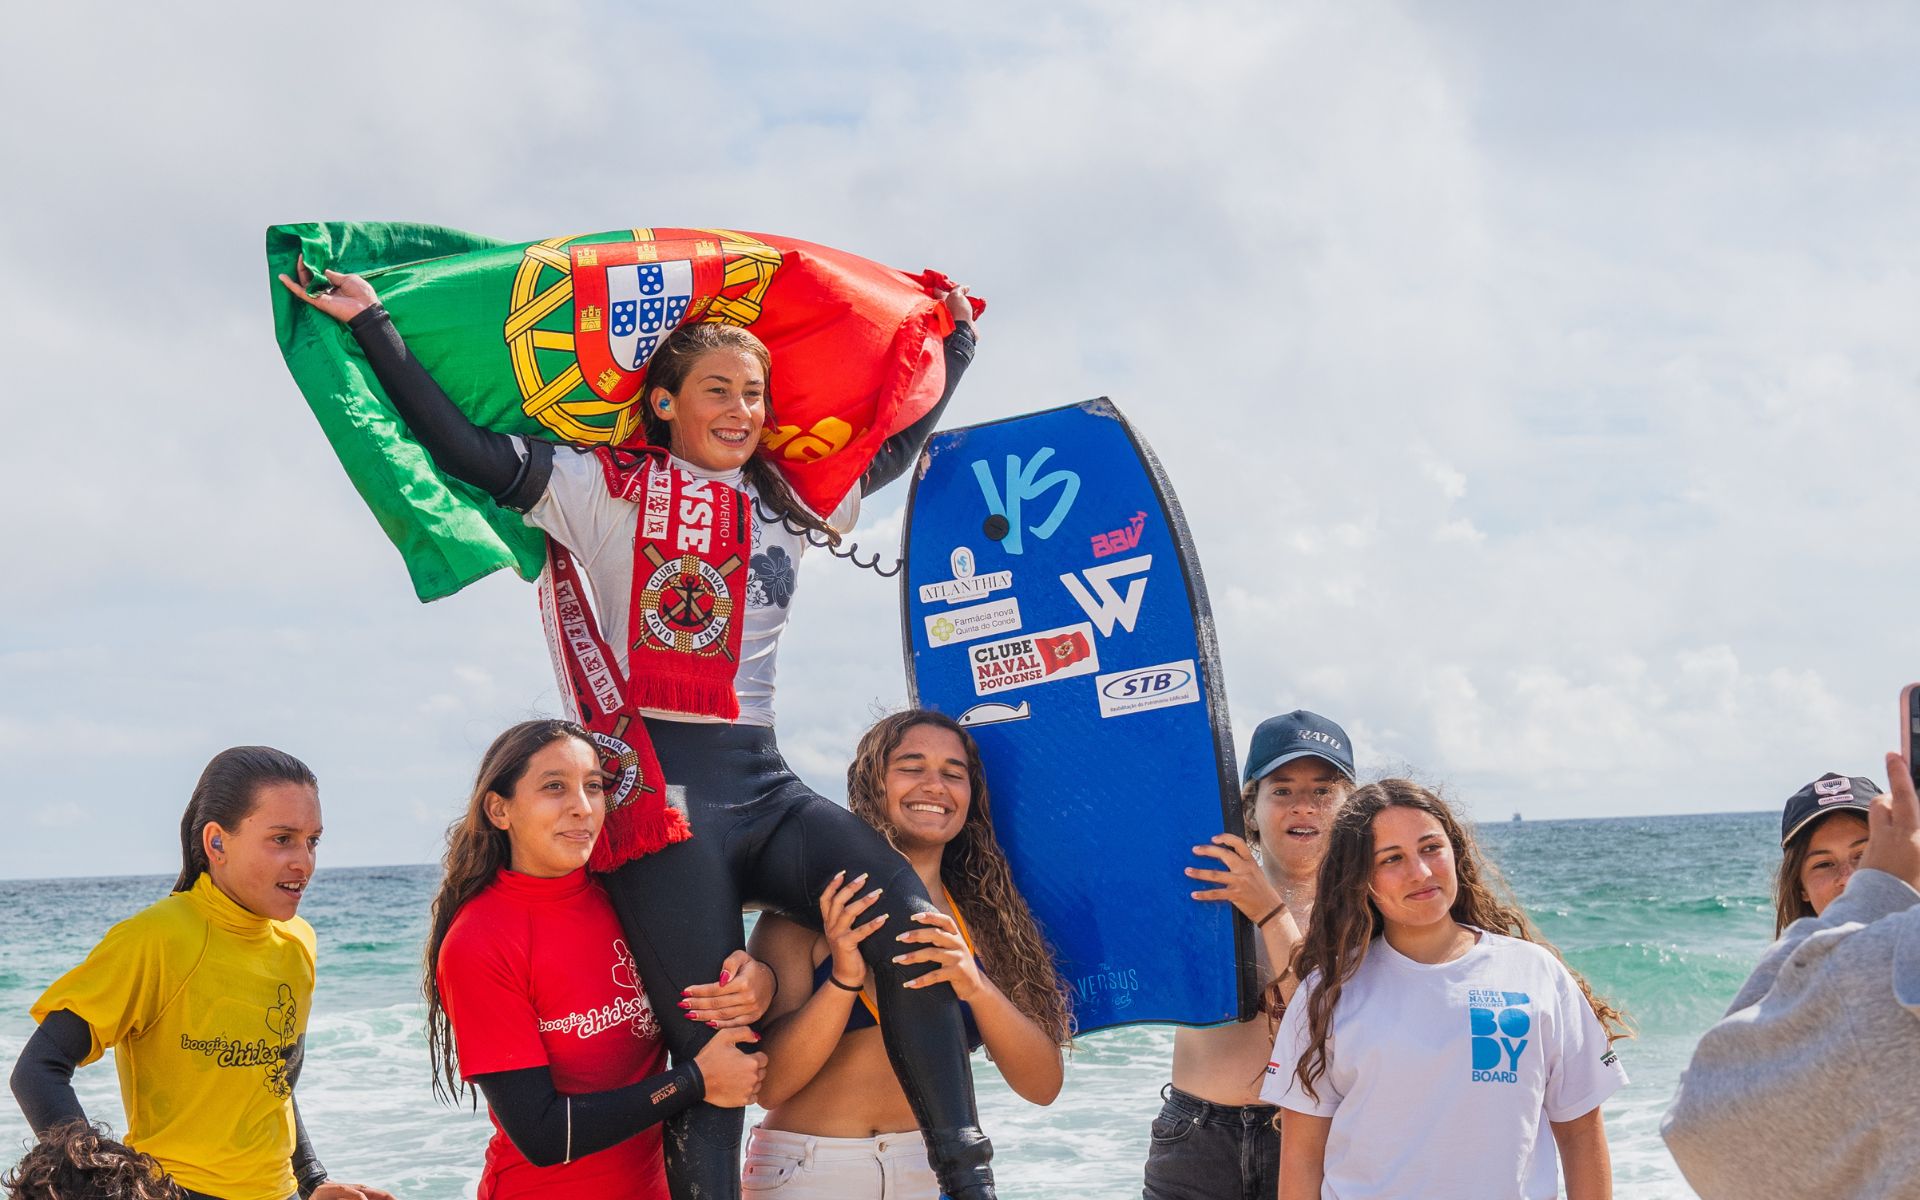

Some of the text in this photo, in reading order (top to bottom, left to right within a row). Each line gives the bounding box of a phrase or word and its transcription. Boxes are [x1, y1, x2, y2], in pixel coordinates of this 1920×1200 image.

[719, 486, 730, 538] POVEIRO
[650, 562, 727, 597] CLUBE NAVAL
[923, 575, 1009, 601] ATLANTHIA
[648, 613, 724, 645] POVO ENSE
[954, 607, 1014, 627] Farmácia nova
[955, 616, 1016, 636] Quinta do Conde
[974, 639, 1033, 663] CLUBE
[976, 654, 1041, 680] NAVAL
[979, 669, 1043, 691] POVOENSE
[1122, 673, 1172, 697] STB
[597, 734, 628, 755] NAVAL
[618, 769, 636, 798] ENSE
[1077, 968, 1139, 1001] VERSUS
[1469, 996, 1503, 1004] NAVAL
[538, 1011, 587, 1034] boogie
[577, 996, 643, 1040] chicks
[181, 1033, 229, 1057] boogie
[1471, 1071, 1518, 1084] BOARD
